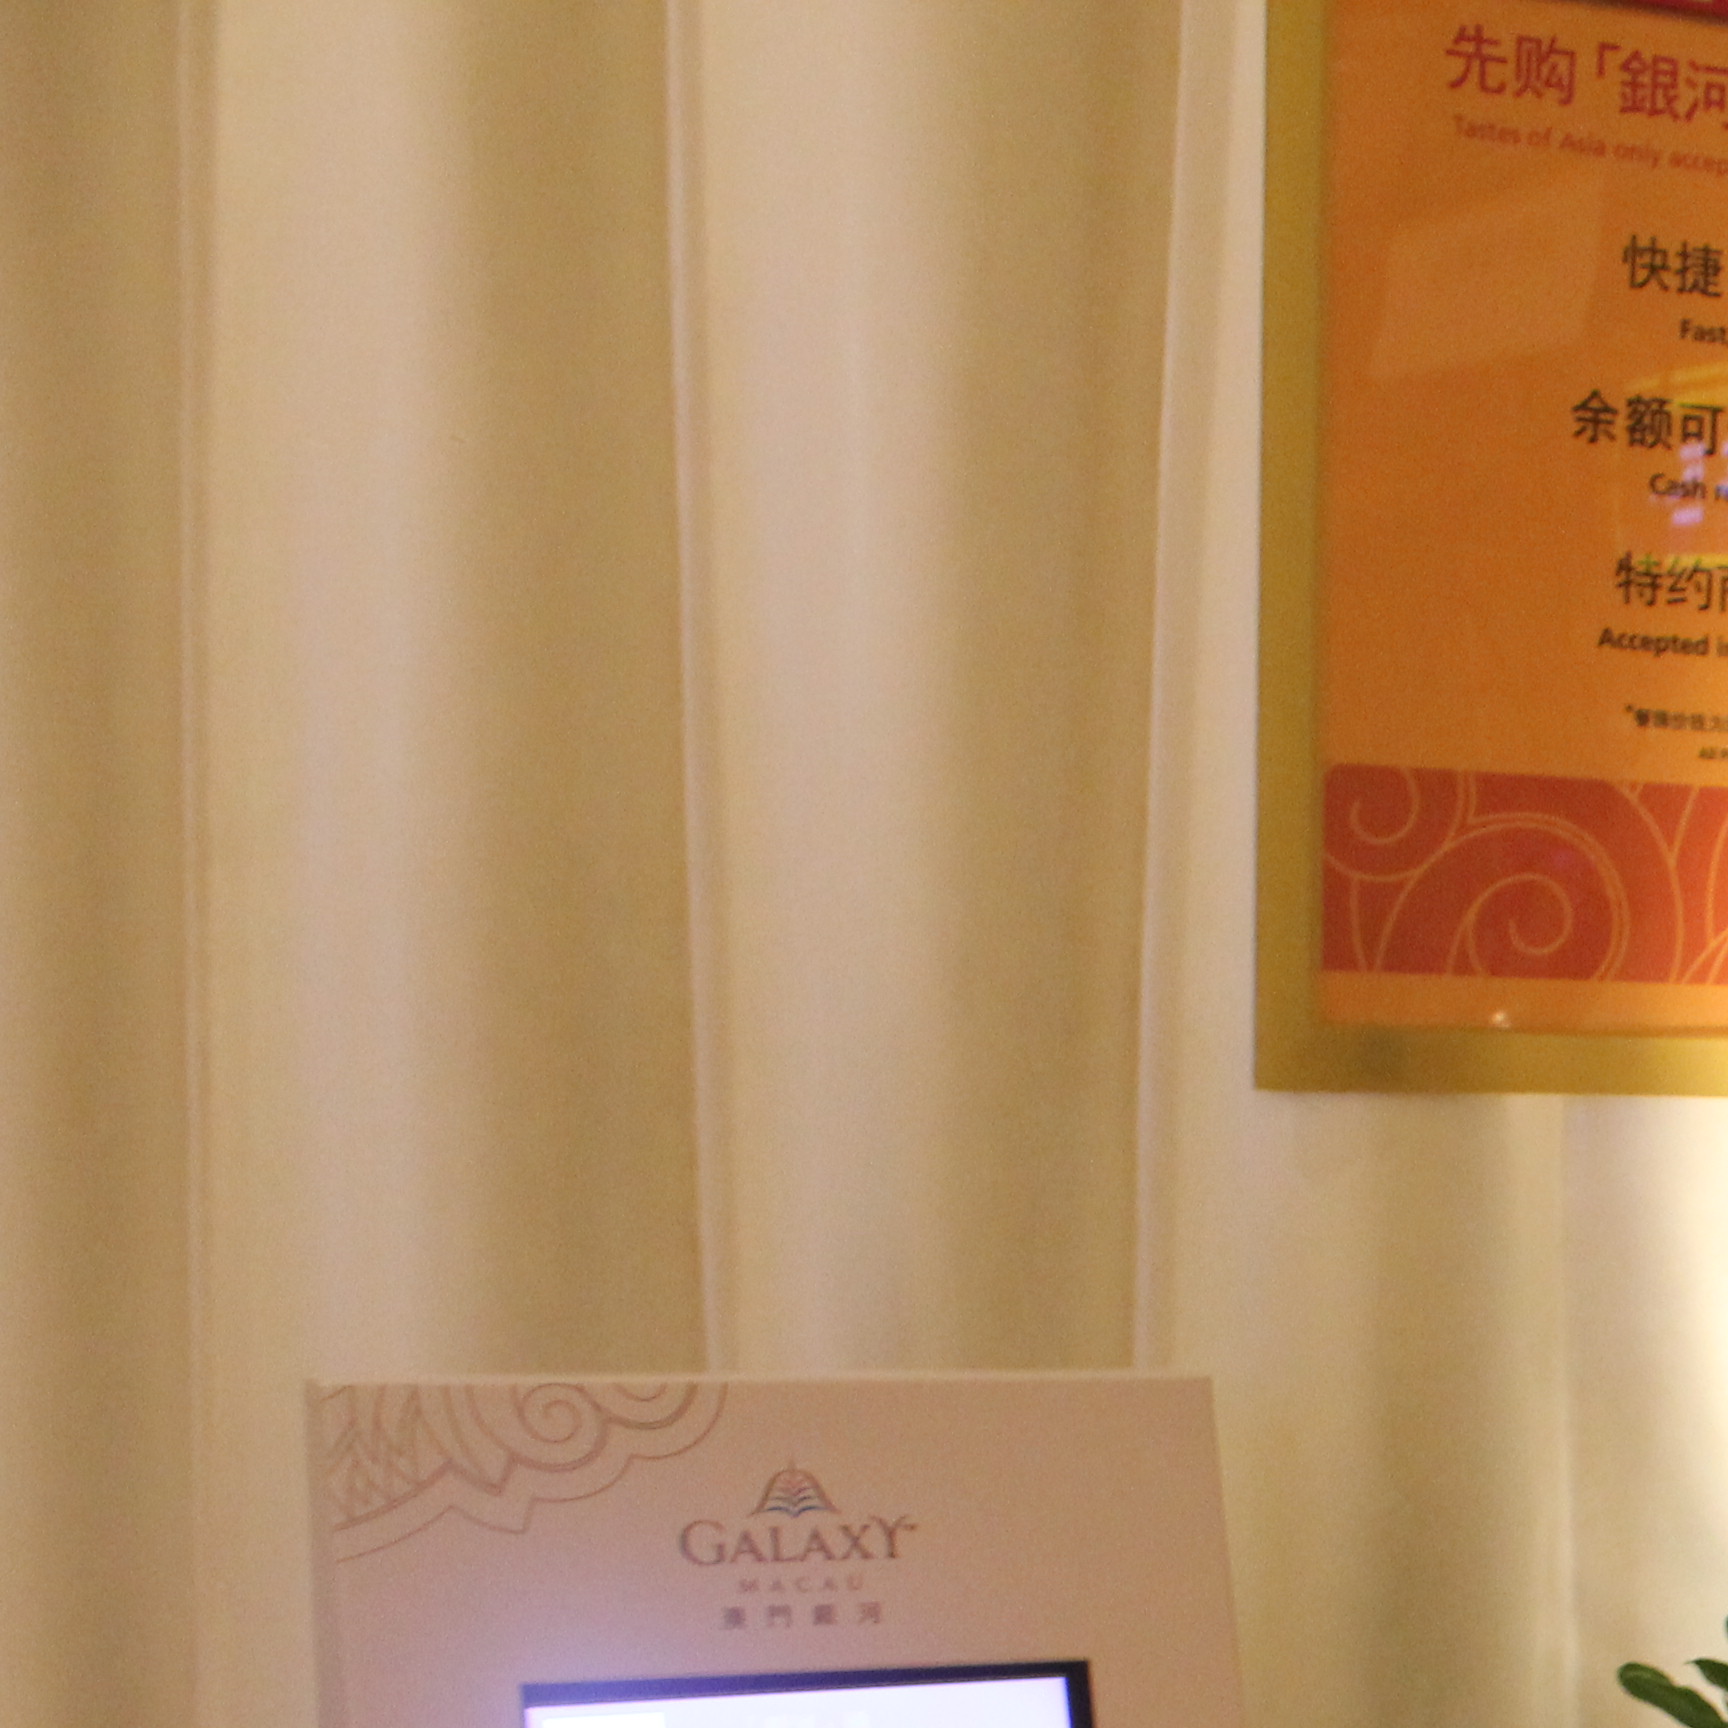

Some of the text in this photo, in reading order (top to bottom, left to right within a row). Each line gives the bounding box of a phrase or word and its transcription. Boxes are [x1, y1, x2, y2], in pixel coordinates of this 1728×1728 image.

[1649, 472, 1706, 500] Cash
[1598, 627, 1709, 657] Accepted
[678, 1514, 912, 1566] GALAXY
